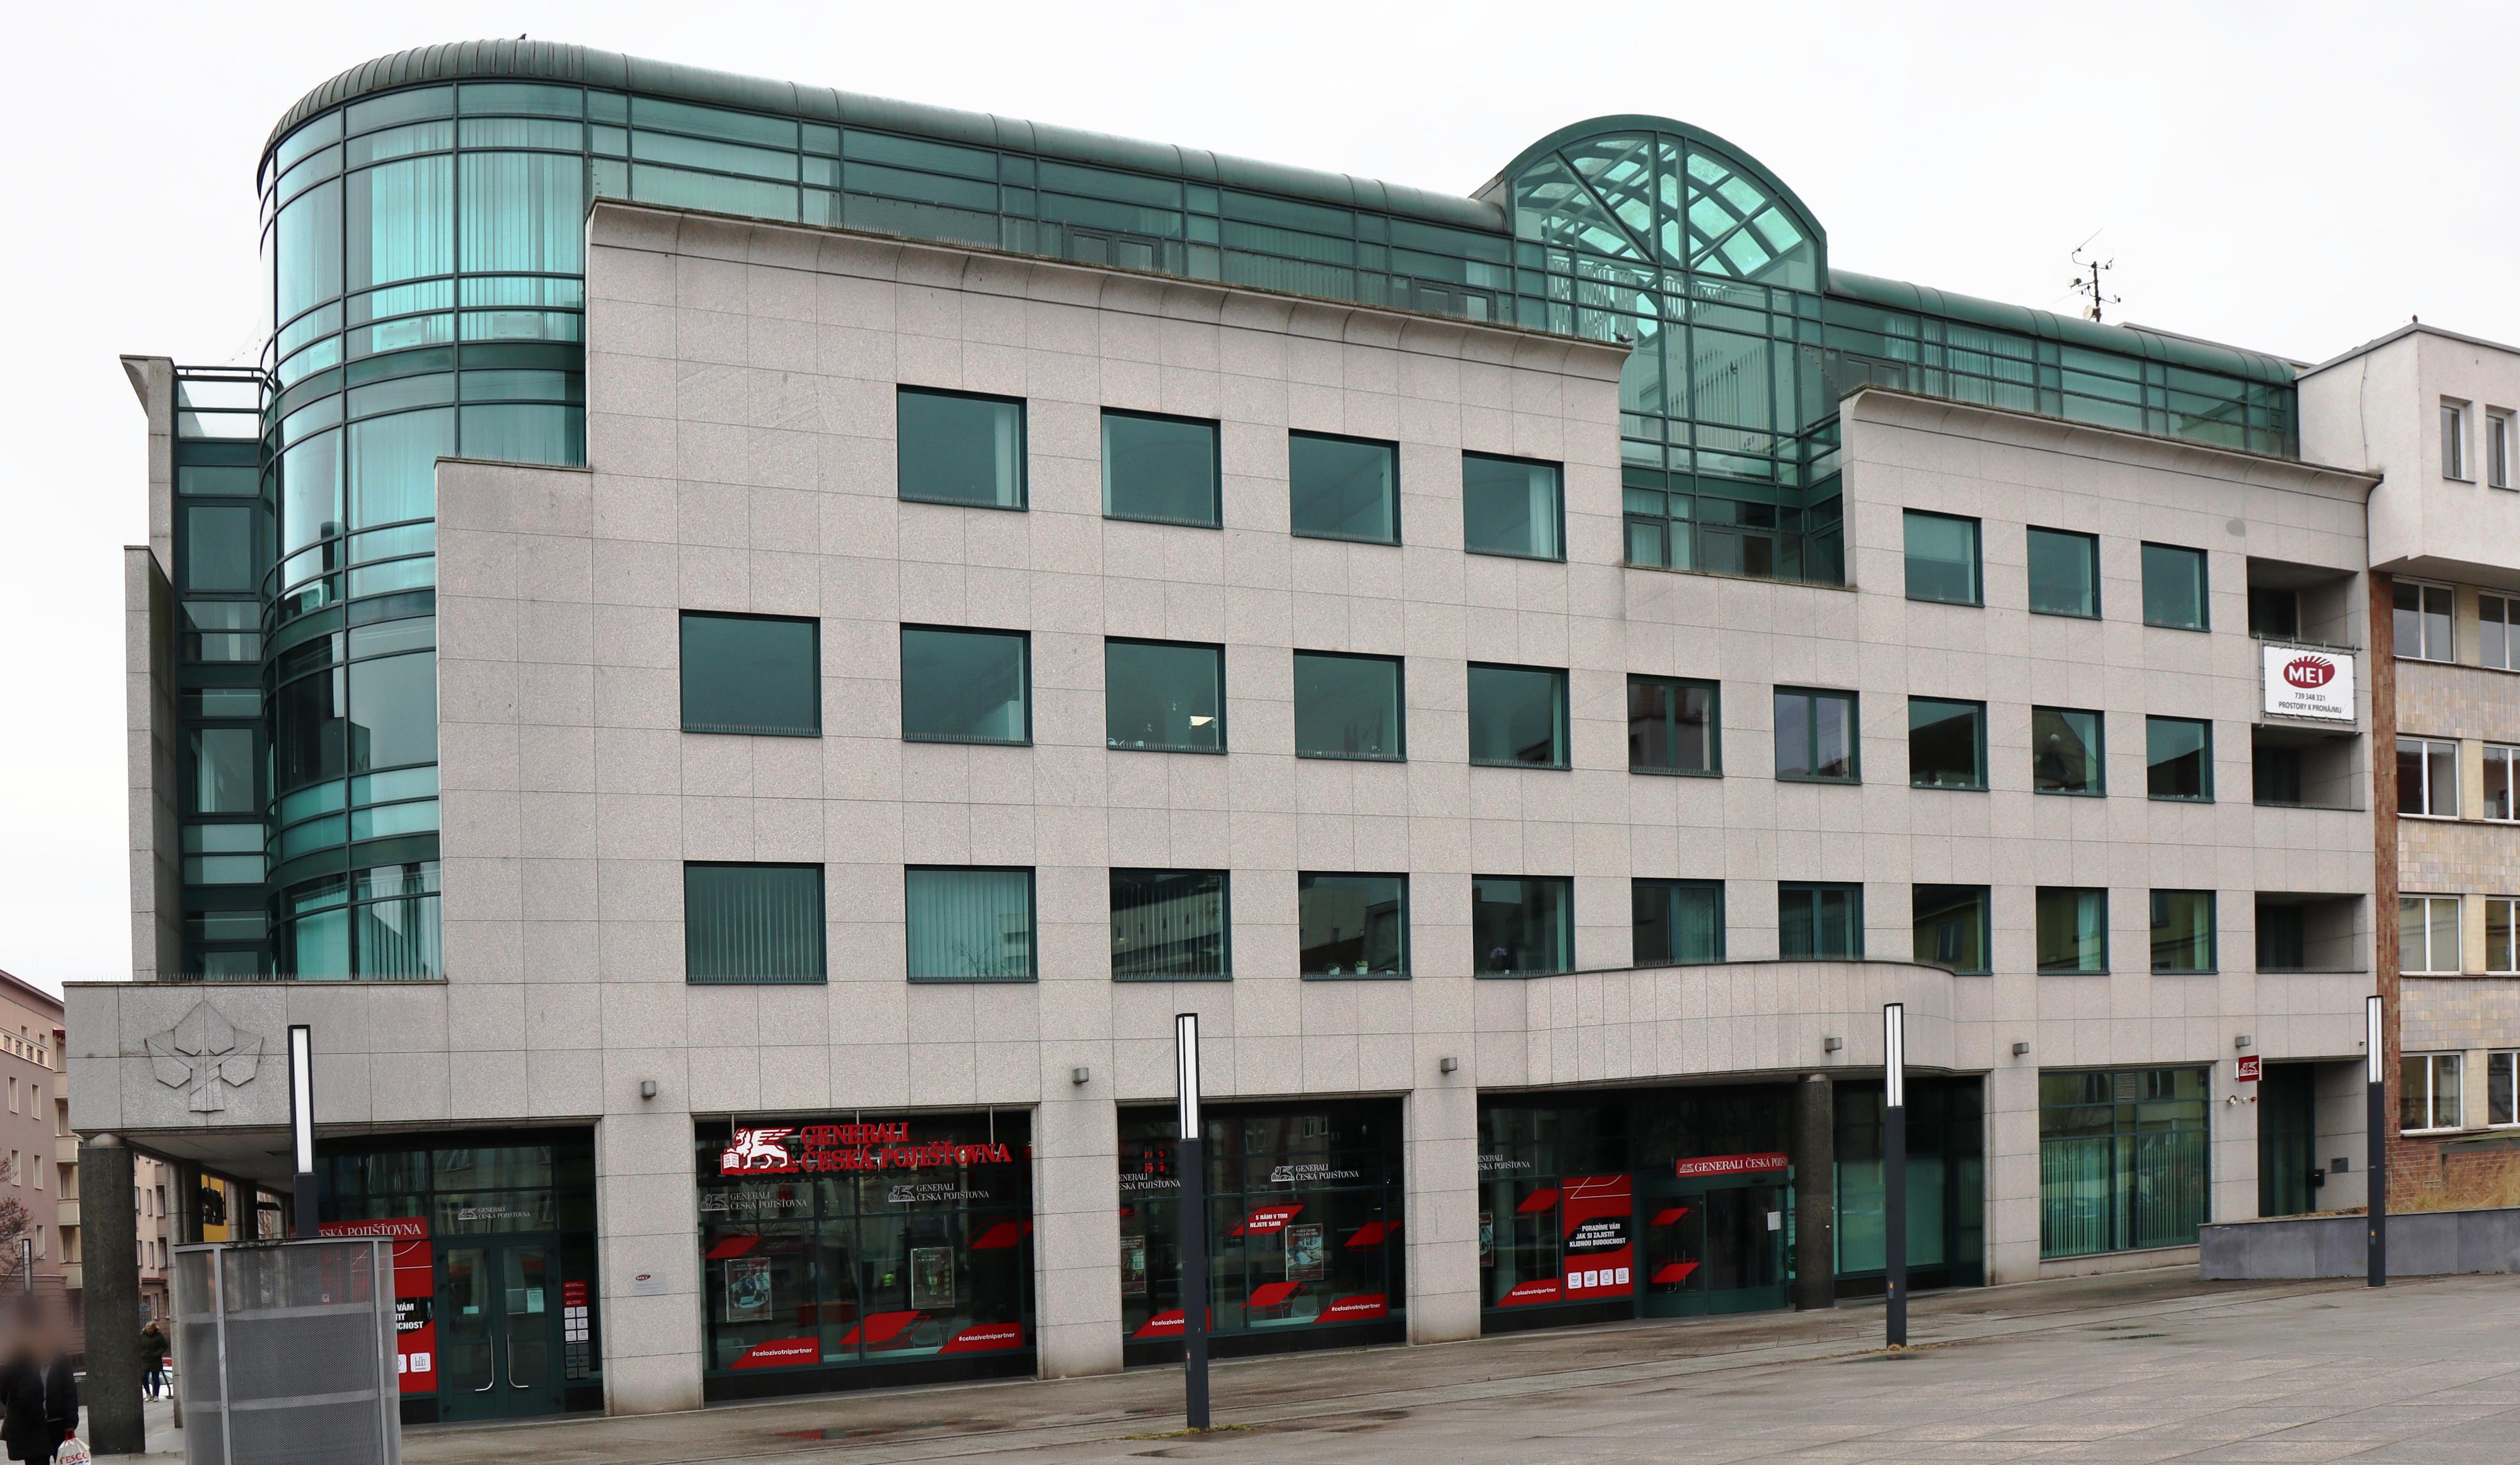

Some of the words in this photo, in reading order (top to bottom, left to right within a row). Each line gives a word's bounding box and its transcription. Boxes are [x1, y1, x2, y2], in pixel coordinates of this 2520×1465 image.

[2289, 665, 2323, 684] MEI
[2279, 701, 2306, 710] PROSTORY
[2312, 704, 2342, 713] PRONÁJMU
[801, 1122, 910, 1145] GENERALI
[801, 1144, 874, 1171] ČESKÁ
[878, 1141, 1012, 1168] POJIŠŤOVNA
[1296, 1164, 1329, 1172] GENERALI
[1478, 1162, 1492, 1170] ESKÁ
[1494, 1161, 1530, 1170] POJIŠŤOVNA
[1695, 1160, 1743, 1172] GENERALI
[1745, 1156, 1770, 1168] ČESKÁ
[1119, 1173, 1148, 1181] ENERALI
[1296, 1171, 1317, 1181] ČESKÁ
[1319, 1170, 1359, 1180] POJIŠŤOVNA
[917, 1183, 954, 1192] GENERALI
[1119, 1181, 1136, 1190] ESKÁ
[1138, 1180, 1181, 1189] POJIŠŤOVNA
[730, 1191, 770, 1200] GENERALI
[917, 1191, 942, 1201] ČESKÁ
[944, 1190, 990, 1200] POJIŠŤOVNA
[730, 1200, 757, 1210] ČESKÁ
[759, 1198, 808, 1209] POJIŠŤOVNA
[319, 1226, 343, 1236] ESKÁ
[347, 1223, 421, 1236] POJIŠŤOVNA
[1582, 1223, 1608, 1232] PORADÍME
[1593, 1238, 1626, 1246] BUDOUCNOST
[397, 1303, 414, 1311] VÁM
[1331, 1303, 1380, 1312] #celozivotnipartner
[959, 1332, 1015, 1342] #celozivotnipartner
[752, 1348, 813, 1357] #celozivotnipartner
